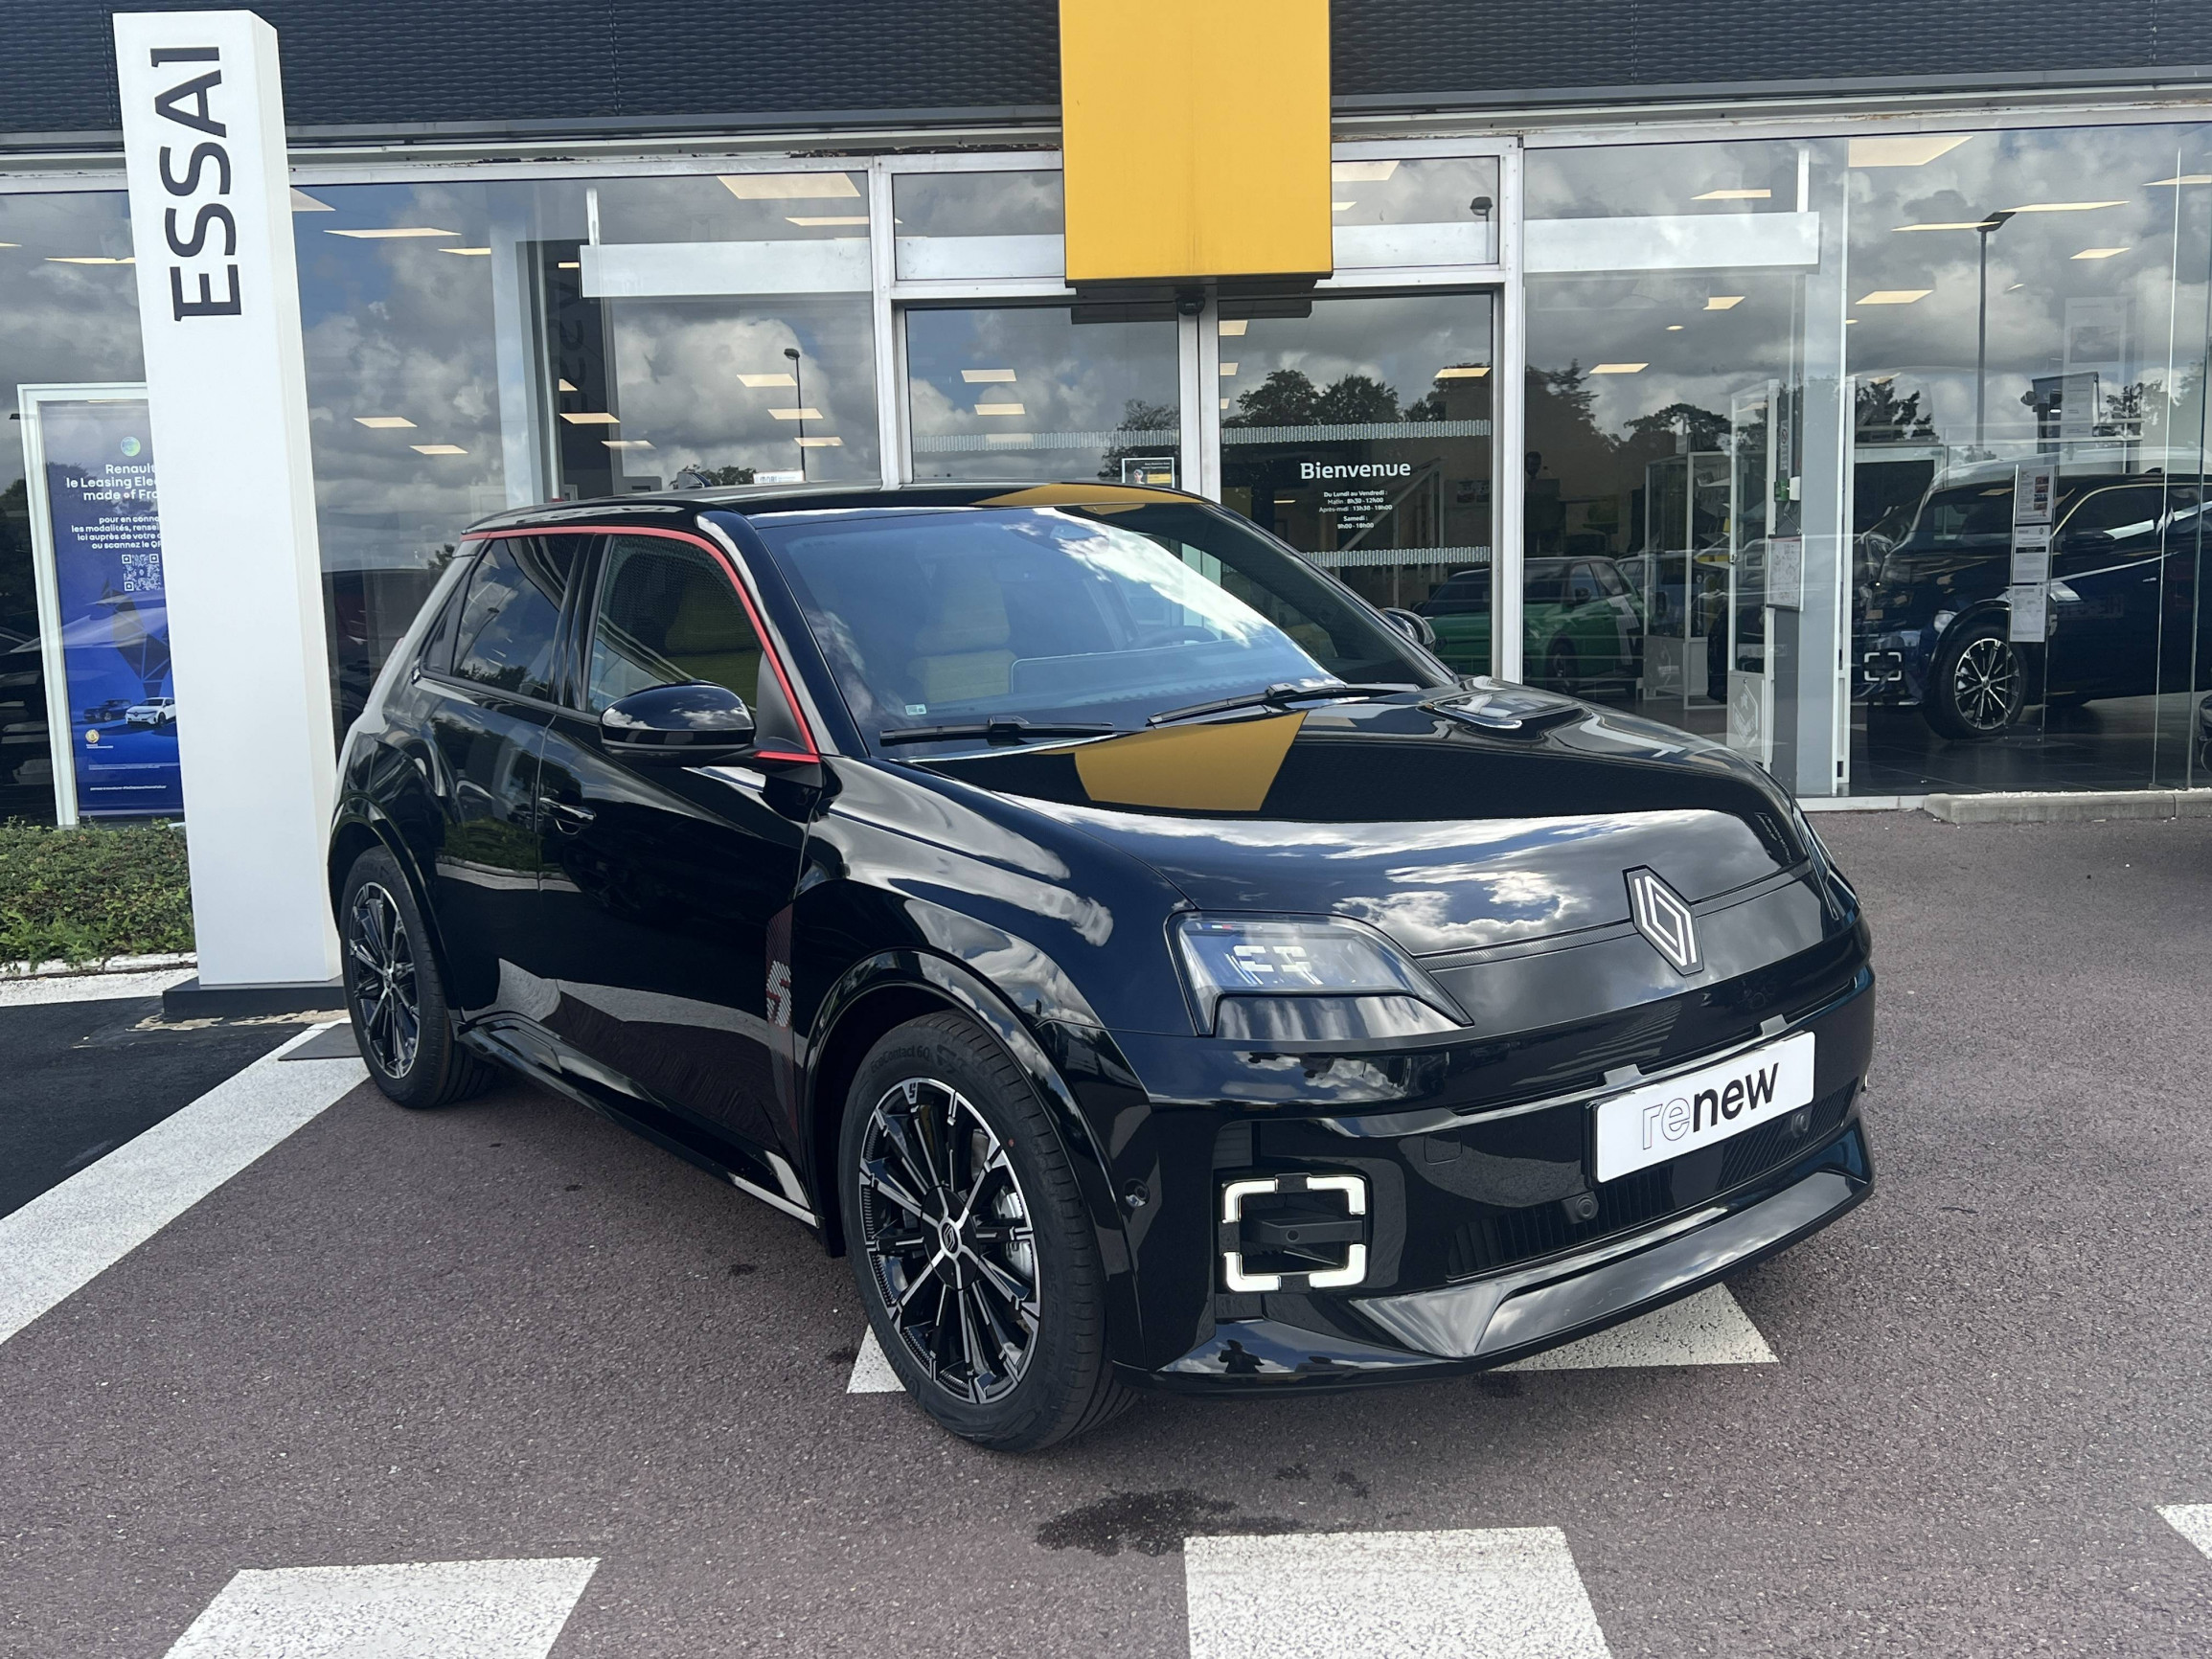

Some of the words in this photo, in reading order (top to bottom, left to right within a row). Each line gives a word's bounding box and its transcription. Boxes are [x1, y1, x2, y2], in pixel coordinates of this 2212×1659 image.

[149, 46, 242, 322] ESSAI
[1299, 461, 1411, 480] Bienvenue
[66, 477, 79, 488] le
[80, 476, 132, 489] Leasing
[82, 489, 122, 501] made
[123, 489, 136, 500] of
[85, 524, 132, 533] modalités,
[89, 533, 120, 542] auprès
[870, 1045, 915, 1074] EcoContact
[1642, 1061, 1779, 1150] renew
